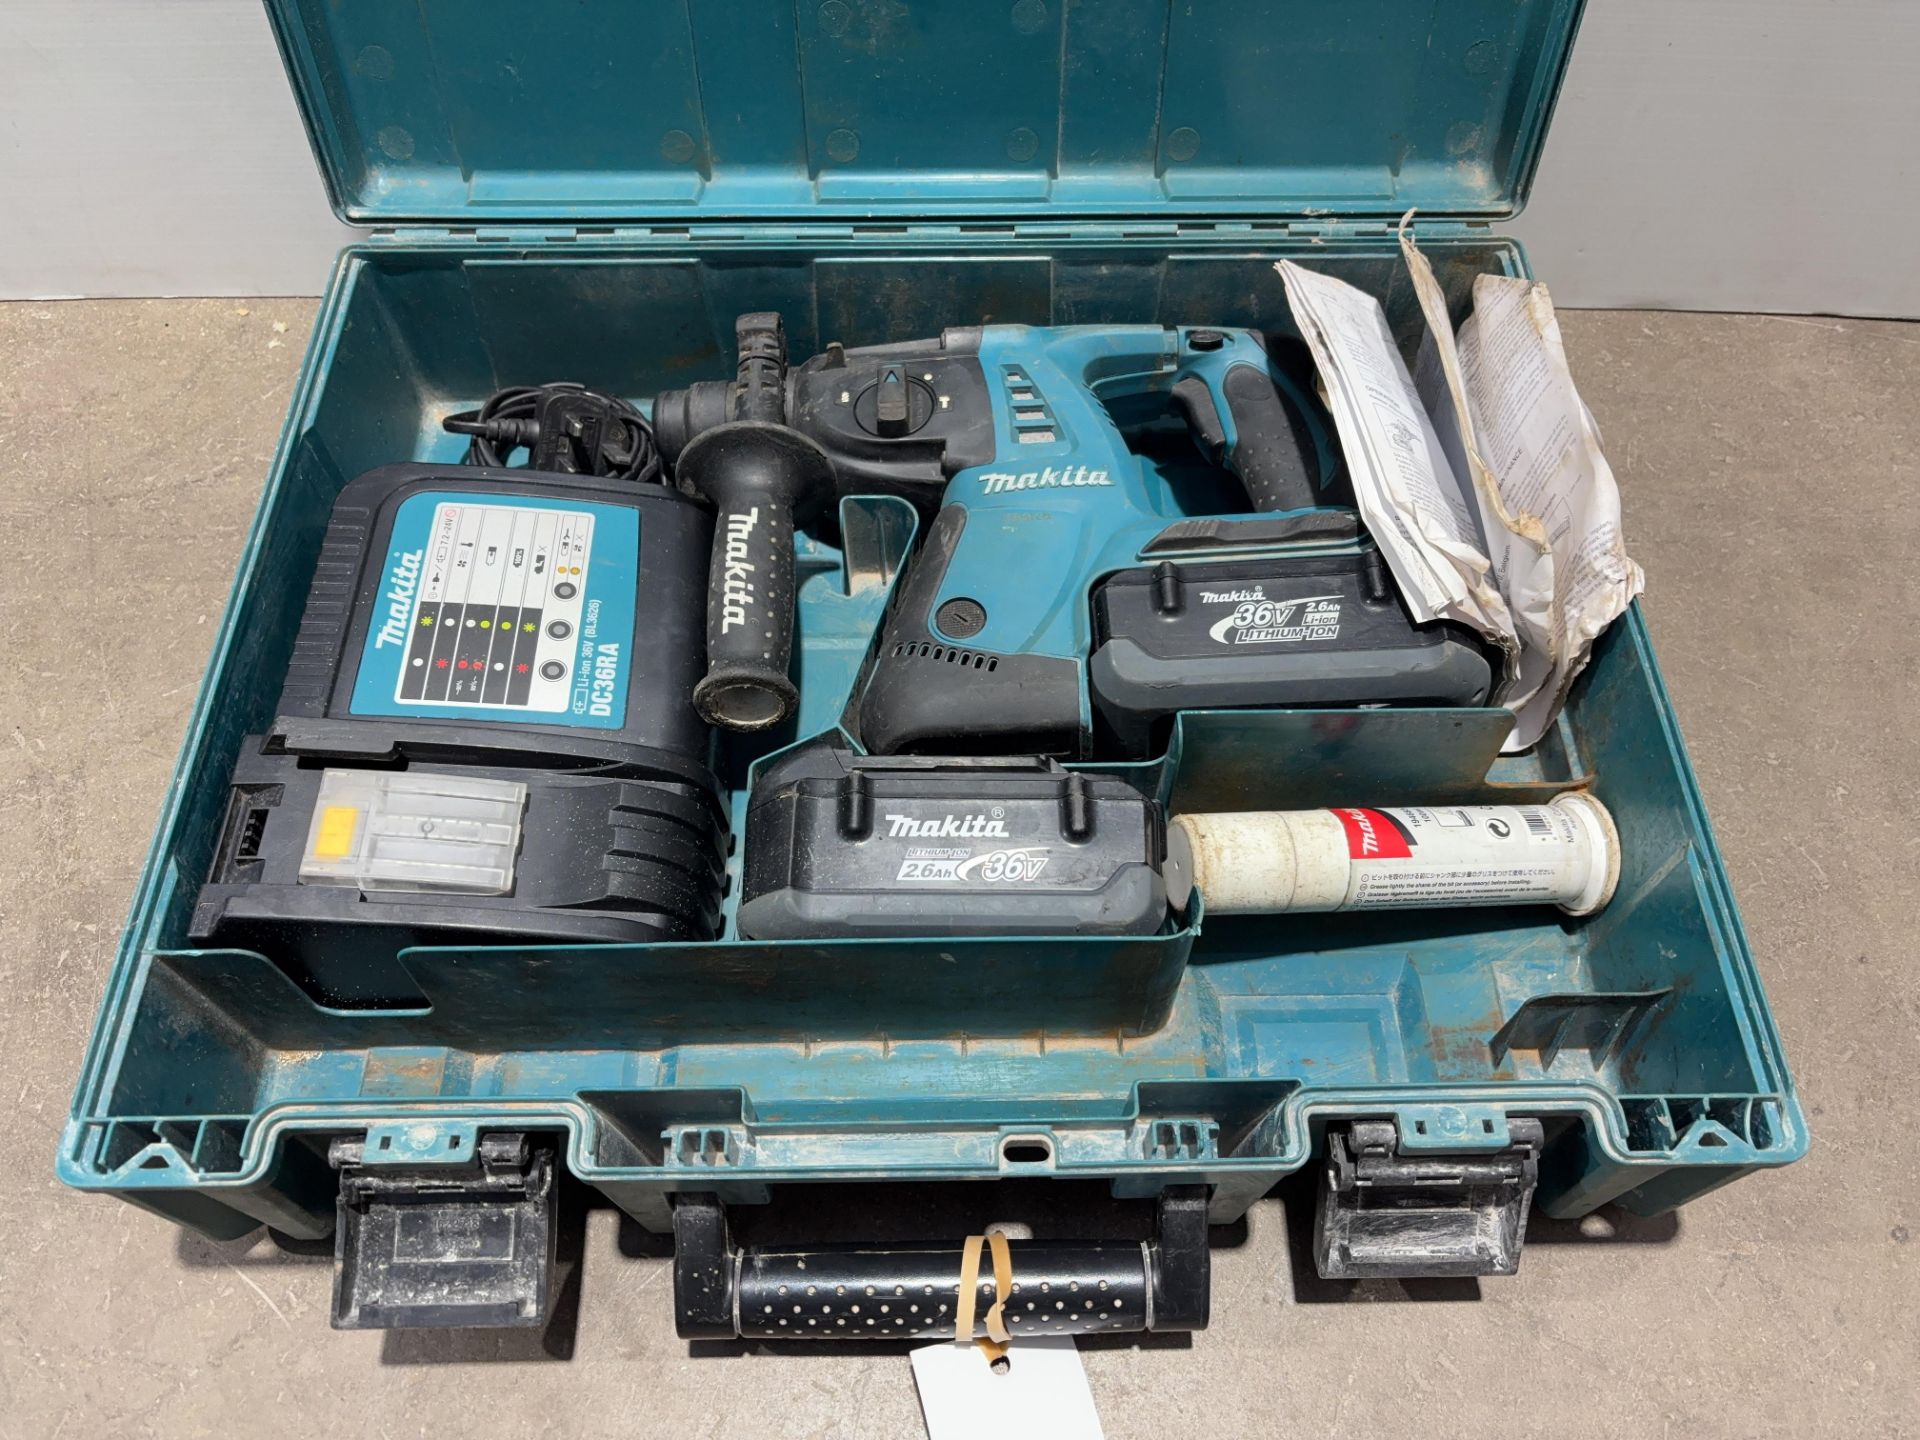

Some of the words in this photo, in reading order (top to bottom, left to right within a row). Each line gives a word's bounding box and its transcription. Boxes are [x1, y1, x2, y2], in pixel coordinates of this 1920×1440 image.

[1305, 601, 1341, 612] 2.6Ah
[586, 598, 602, 638] (BL3626)
[1303, 612, 1338, 625] Li-ion
[584, 638, 594, 655] 36V
[580, 656, 590, 687] Li-ion
[590, 642, 619, 716] DC36RA
[901, 862, 953, 879] 2.6Ah
